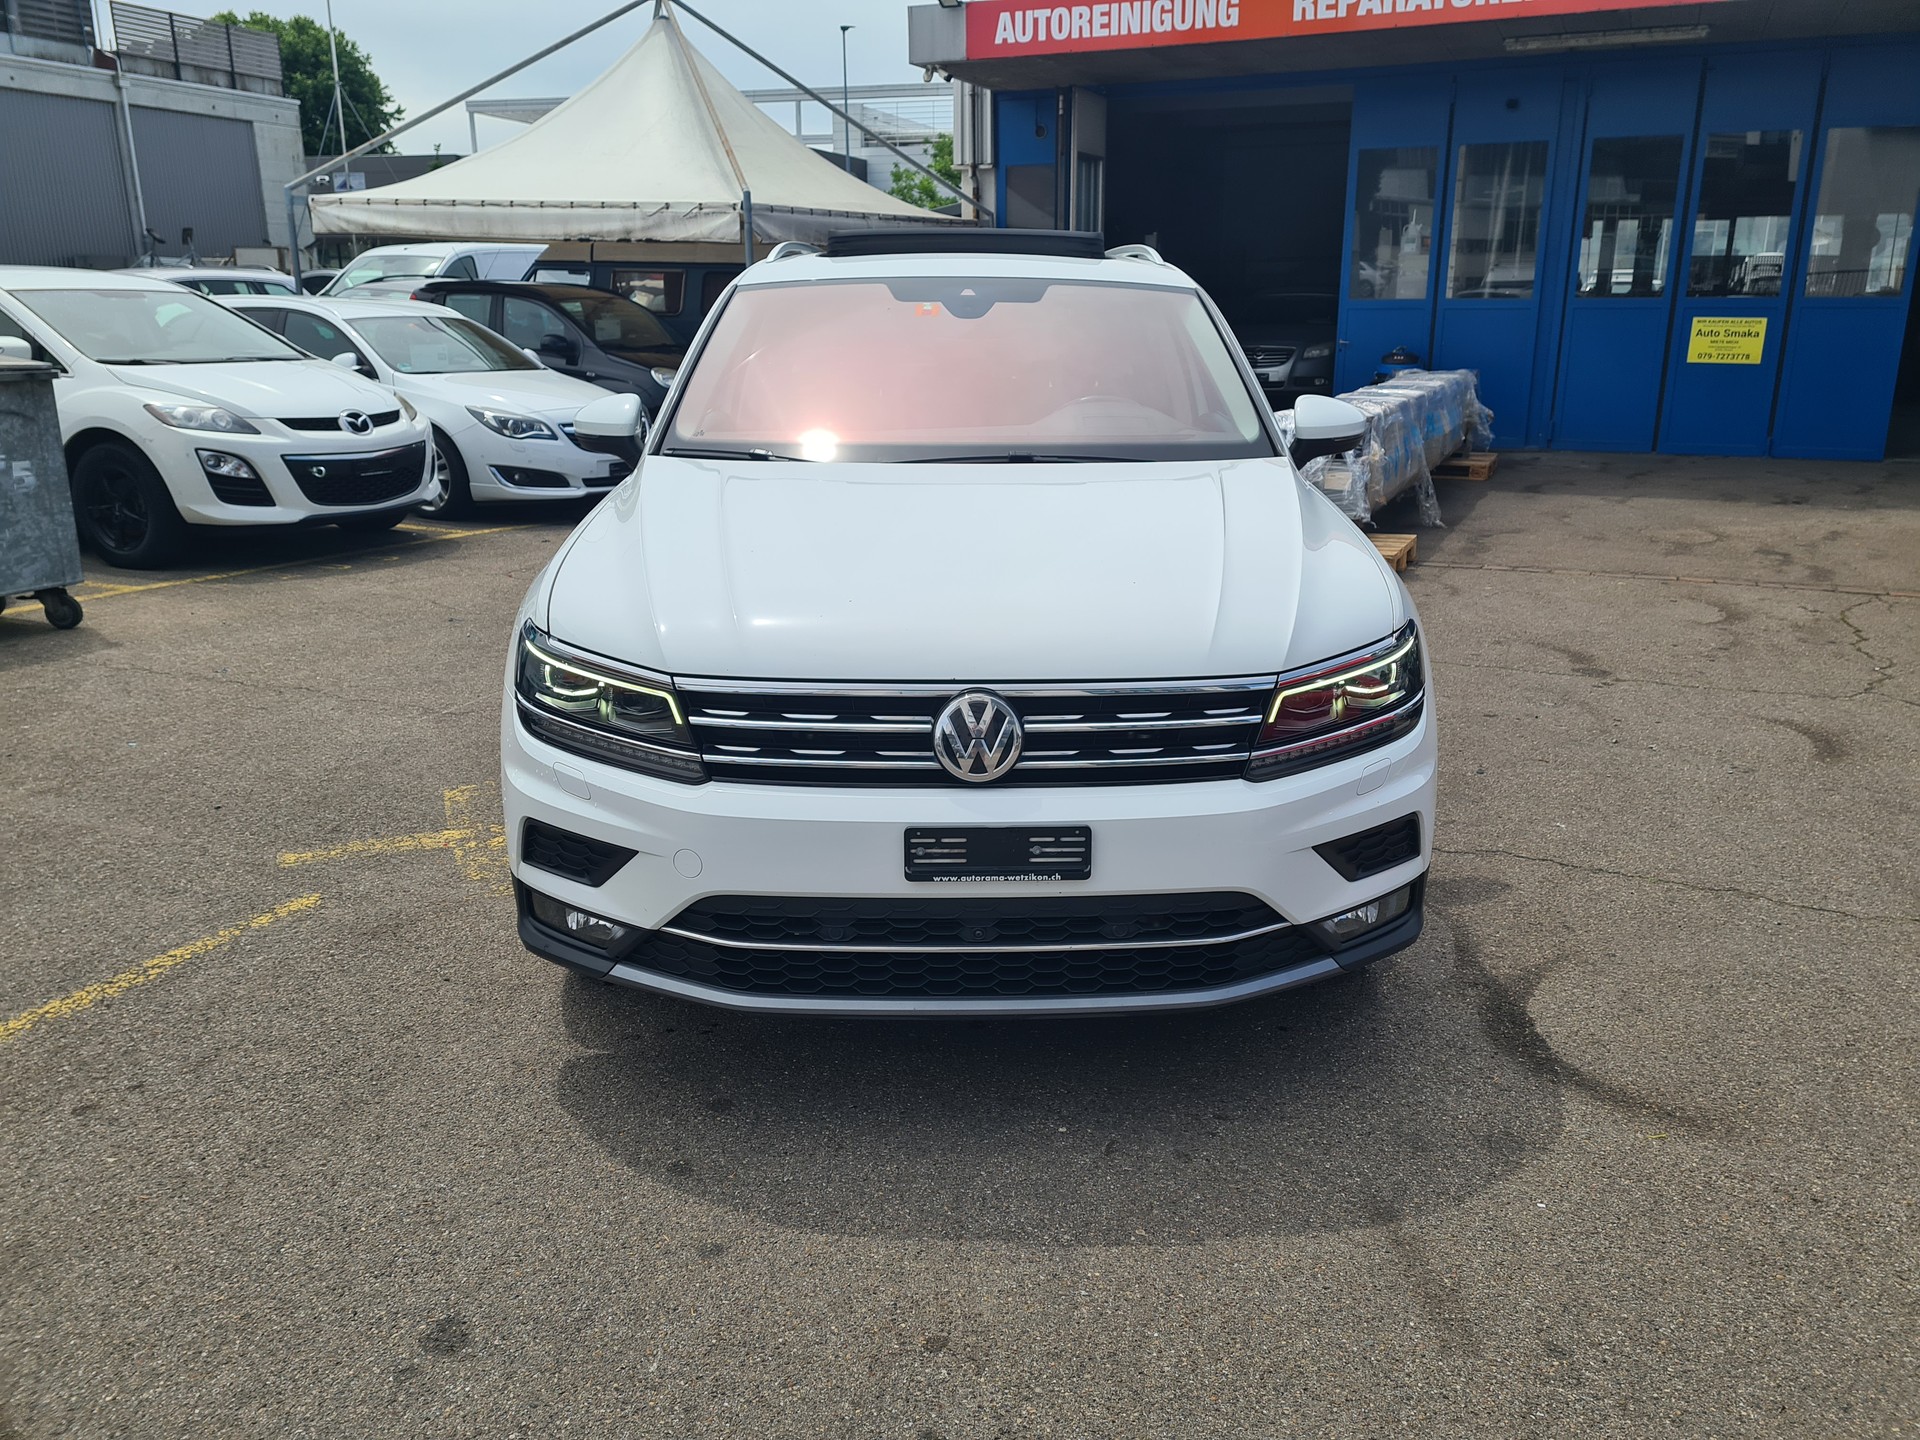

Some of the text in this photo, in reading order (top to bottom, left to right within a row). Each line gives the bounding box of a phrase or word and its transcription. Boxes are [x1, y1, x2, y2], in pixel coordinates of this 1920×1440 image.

[994, 0, 1240, 45] AUTOREINIGUNG
[1695, 328, 1760, 338] Auto Smaka
[933, 873, 1062, 882] www.autorama-wetzikon.ch
